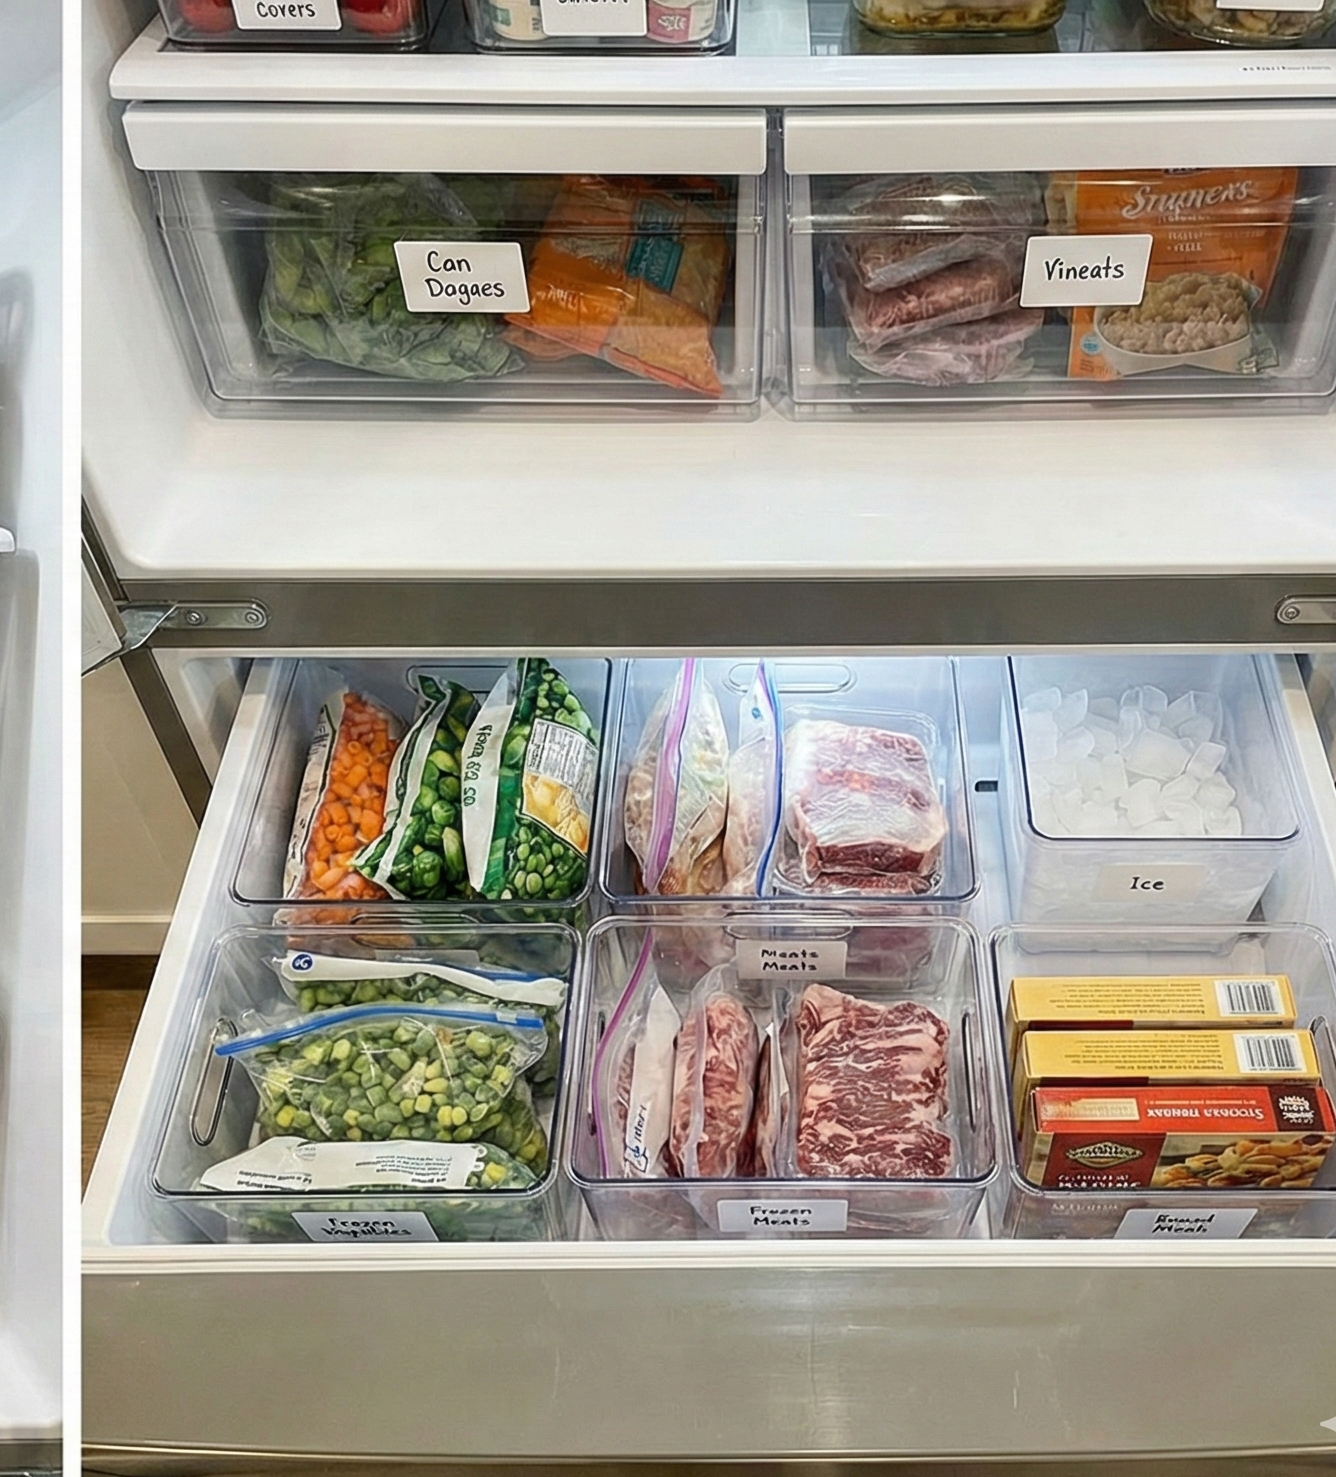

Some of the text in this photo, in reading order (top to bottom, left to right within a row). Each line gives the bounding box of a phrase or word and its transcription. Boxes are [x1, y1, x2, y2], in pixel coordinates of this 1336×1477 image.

[427, 250, 472, 273] Can
[1044, 255, 1124, 281] Vineats
[424, 277, 505, 306] Dagaes
[1130, 876, 1164, 891] Ice
